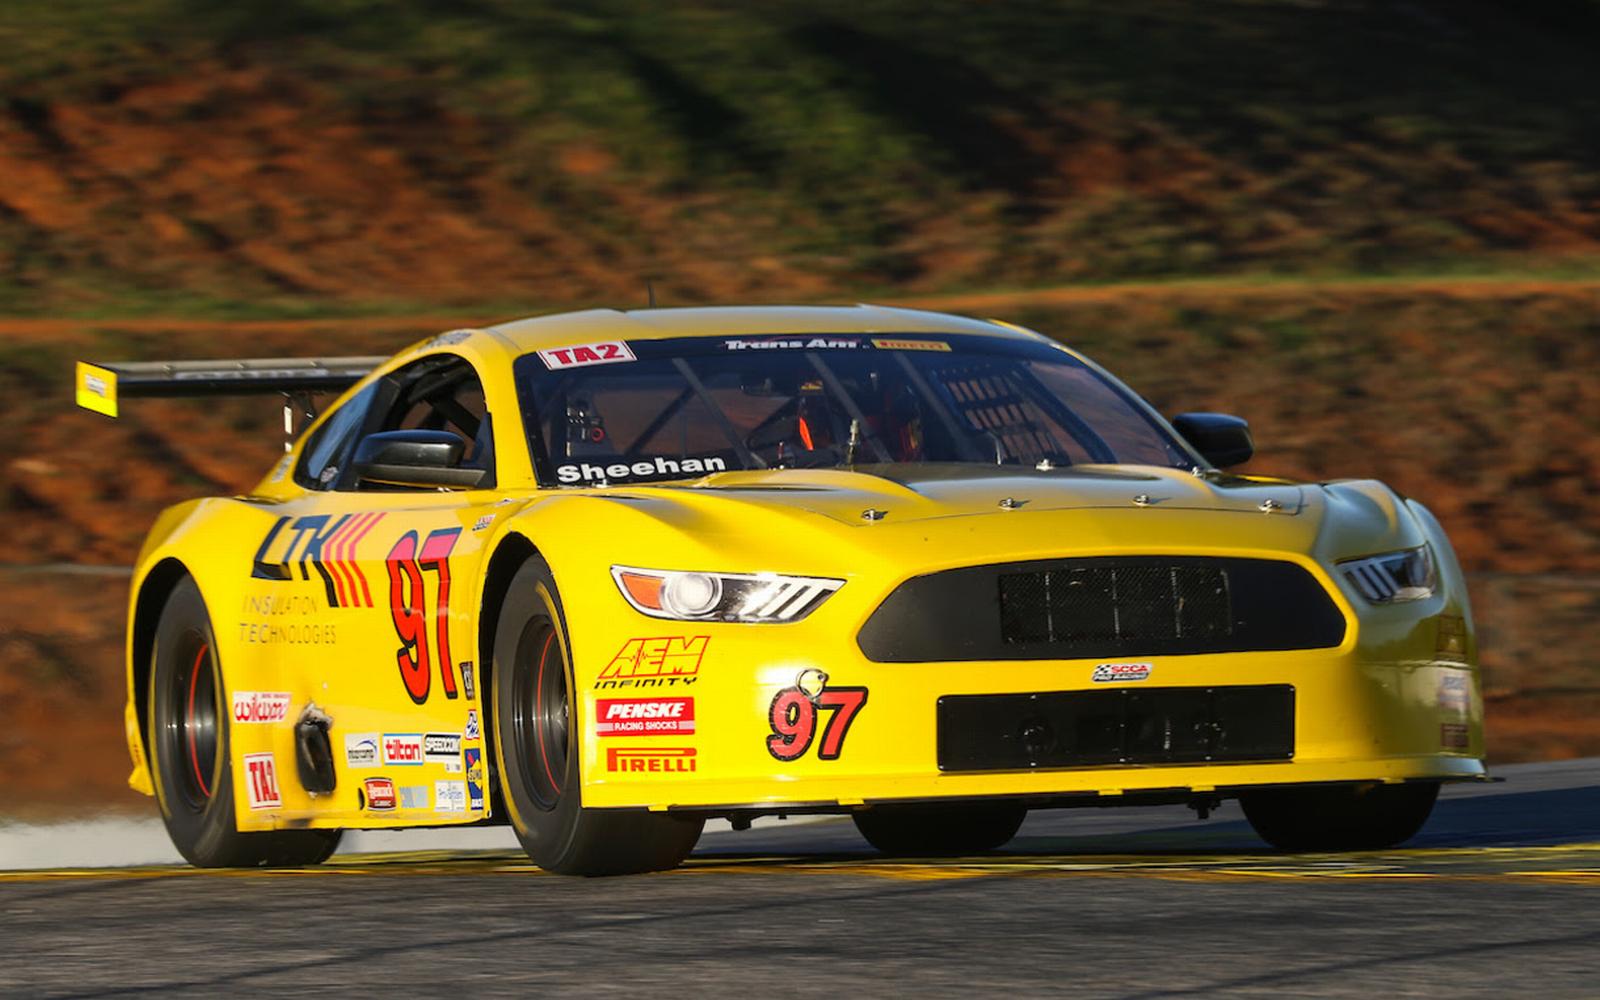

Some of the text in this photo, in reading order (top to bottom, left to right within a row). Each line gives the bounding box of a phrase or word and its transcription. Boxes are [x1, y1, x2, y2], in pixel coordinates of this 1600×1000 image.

[548, 343, 626, 366] TA2
[725, 338, 858, 350] Trans Am
[557, 455, 726, 484] Sheehan
[241, 595, 318, 616] INSULATION
[386, 527, 463, 705] 97
[239, 622, 337, 645] TECHNOLOGIES
[597, 635, 711, 680] AEM
[1111, 664, 1149, 674] SCCA
[593, 677, 698, 689] INFINITY
[606, 702, 686, 719] PENSKE
[614, 720, 678, 731] RACING SHOCKS
[766, 686, 869, 762] 97
[385, 739, 421, 760] tilton
[606, 747, 697, 772] PIRELLI
[249, 760, 279, 803] TA2
